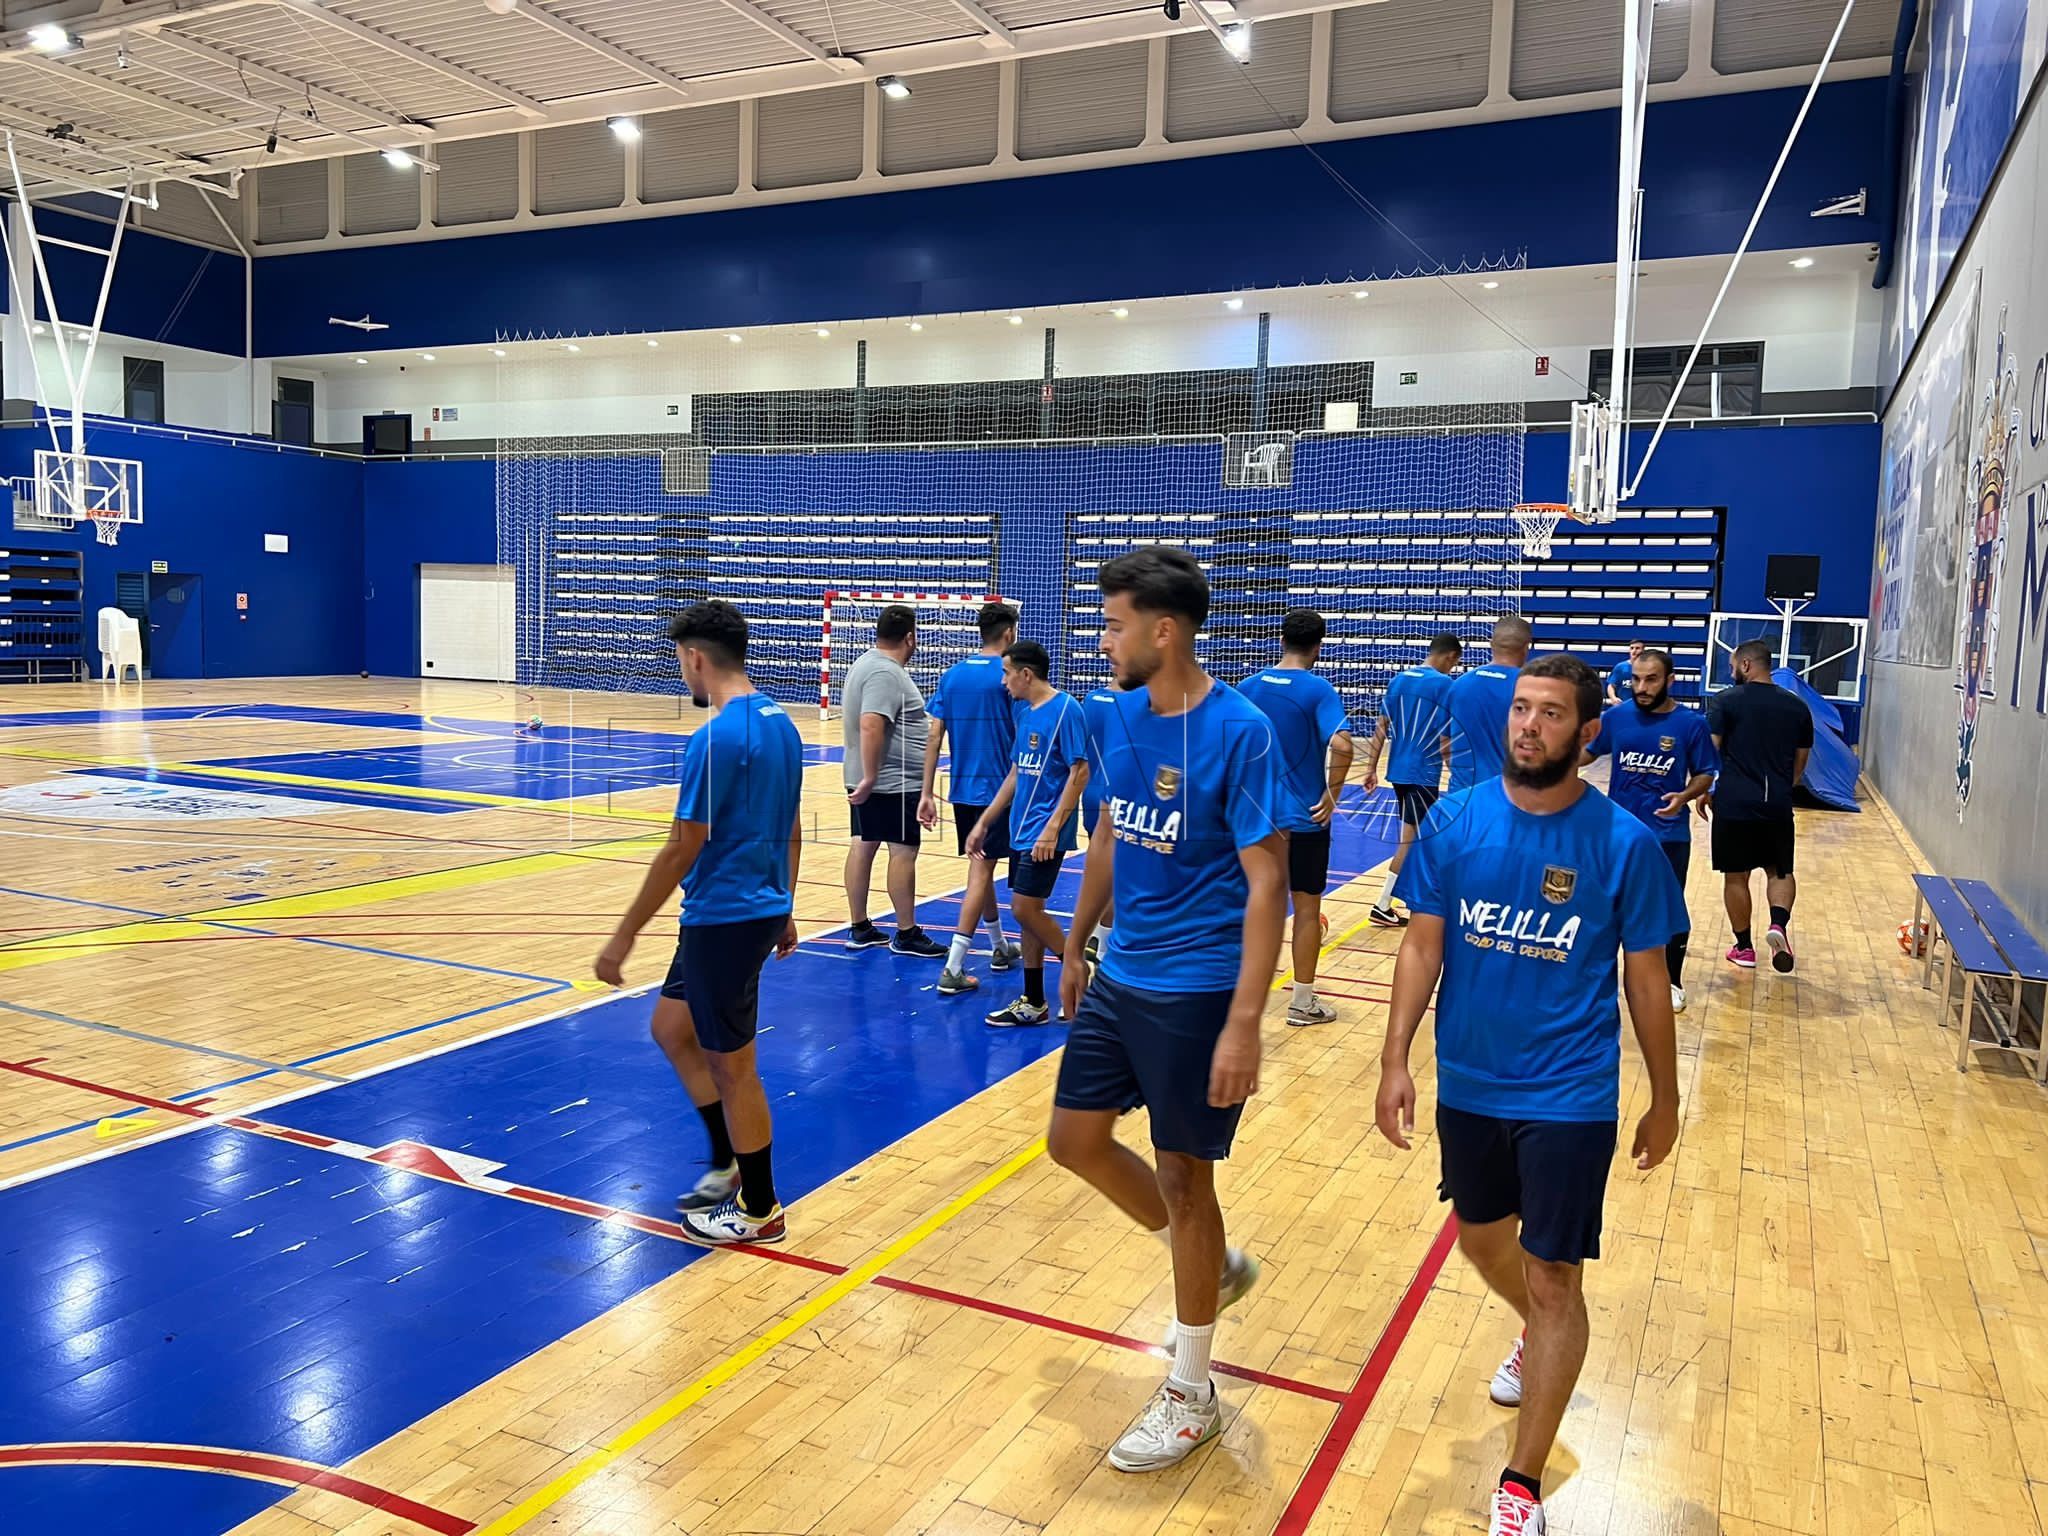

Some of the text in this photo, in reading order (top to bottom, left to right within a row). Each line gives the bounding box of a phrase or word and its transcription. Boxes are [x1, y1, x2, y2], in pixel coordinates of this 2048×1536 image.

[1618, 751, 1675, 771] MELILLA
[114, 854, 241, 873] Melilla
[1459, 898, 1582, 950] MELILLA
[1496, 940, 1515, 953] DEL
[1519, 944, 1569, 963] DEPORTE
